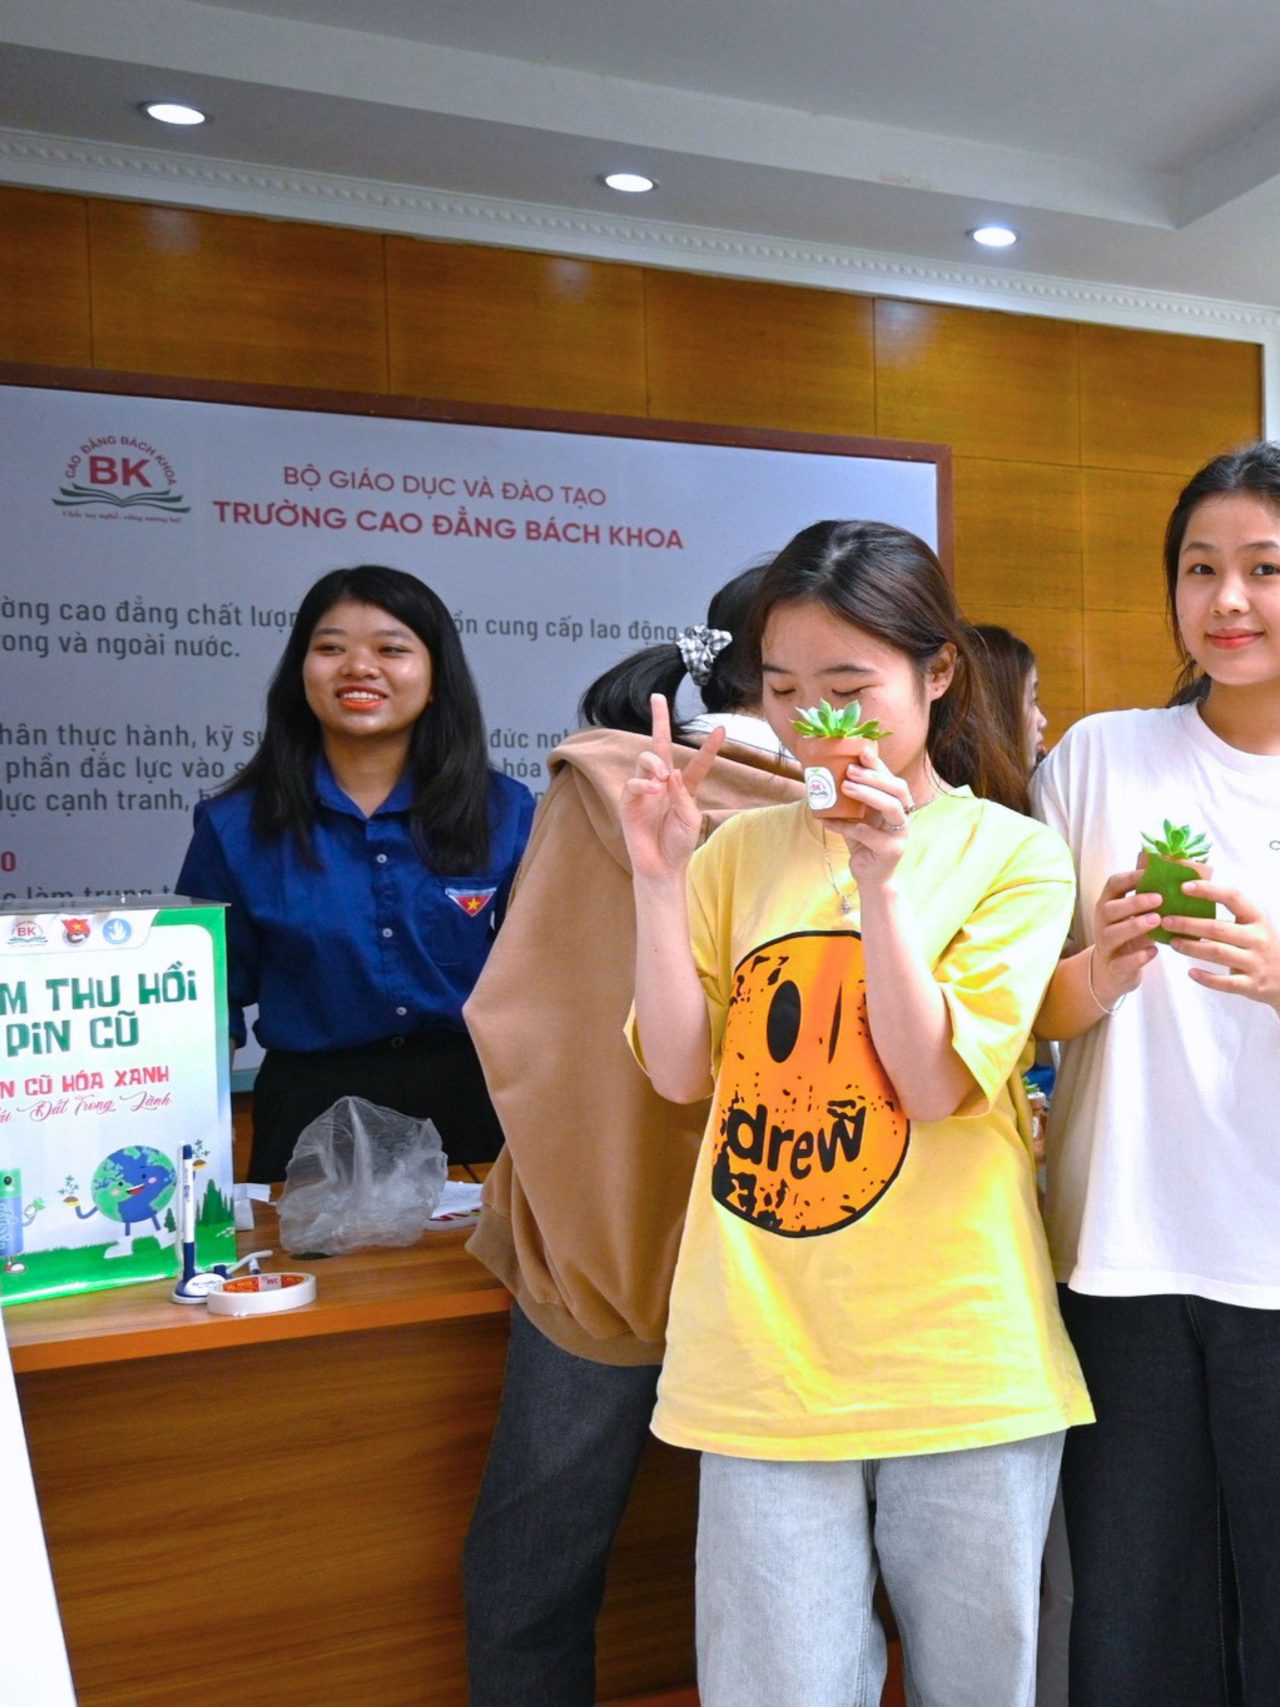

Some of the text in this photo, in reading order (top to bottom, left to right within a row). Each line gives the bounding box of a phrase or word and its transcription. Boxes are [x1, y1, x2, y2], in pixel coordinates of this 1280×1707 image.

[89, 455, 153, 488] BK
[154, 454, 177, 486] KHOA
[283, 463, 607, 510] BỘ GIÁO DỤC VÀ ĐÀO TẠO
[212, 499, 347, 530] TRƯỜNG
[356, 510, 423, 534] CAO
[432, 506, 517, 540] ĐẲNG
[525, 516, 601, 545] BÁCH
[609, 525, 684, 550] KHOA
[1, 595, 49, 626] ờng
[59, 602, 106, 622] cao
[115, 595, 179, 629] đẳng
[187, 601, 243, 627] chất
[485, 619, 538, 641] cung
[545, 615, 583, 642] cấp
[590, 618, 621, 639] lao
[0, 631, 240, 660] ong và ngoài nước.
[56, 724, 117, 752] thực
[126, 724, 197, 749] hành,
[206, 724, 234, 752] kỹ
[489, 728, 529, 749] đức
[6, 752, 70, 783] phần
[80, 751, 126, 779] đắc
[136, 756, 173, 784] lực
[182, 757, 225, 778] vào
[503, 757, 541, 778] hóa
[46, 789, 107, 817] cạnh
[118, 788, 189, 812] tranh,
[0, 981, 28, 1015] M
[45, 975, 121, 1011] THU
[89, 1010, 139, 1049] CŨ
[24, 1074, 53, 1096] CŨ
[62, 1070, 104, 1093] HÓA
[114, 1065, 169, 1087] XANH
[727, 1104, 867, 1179] drew
